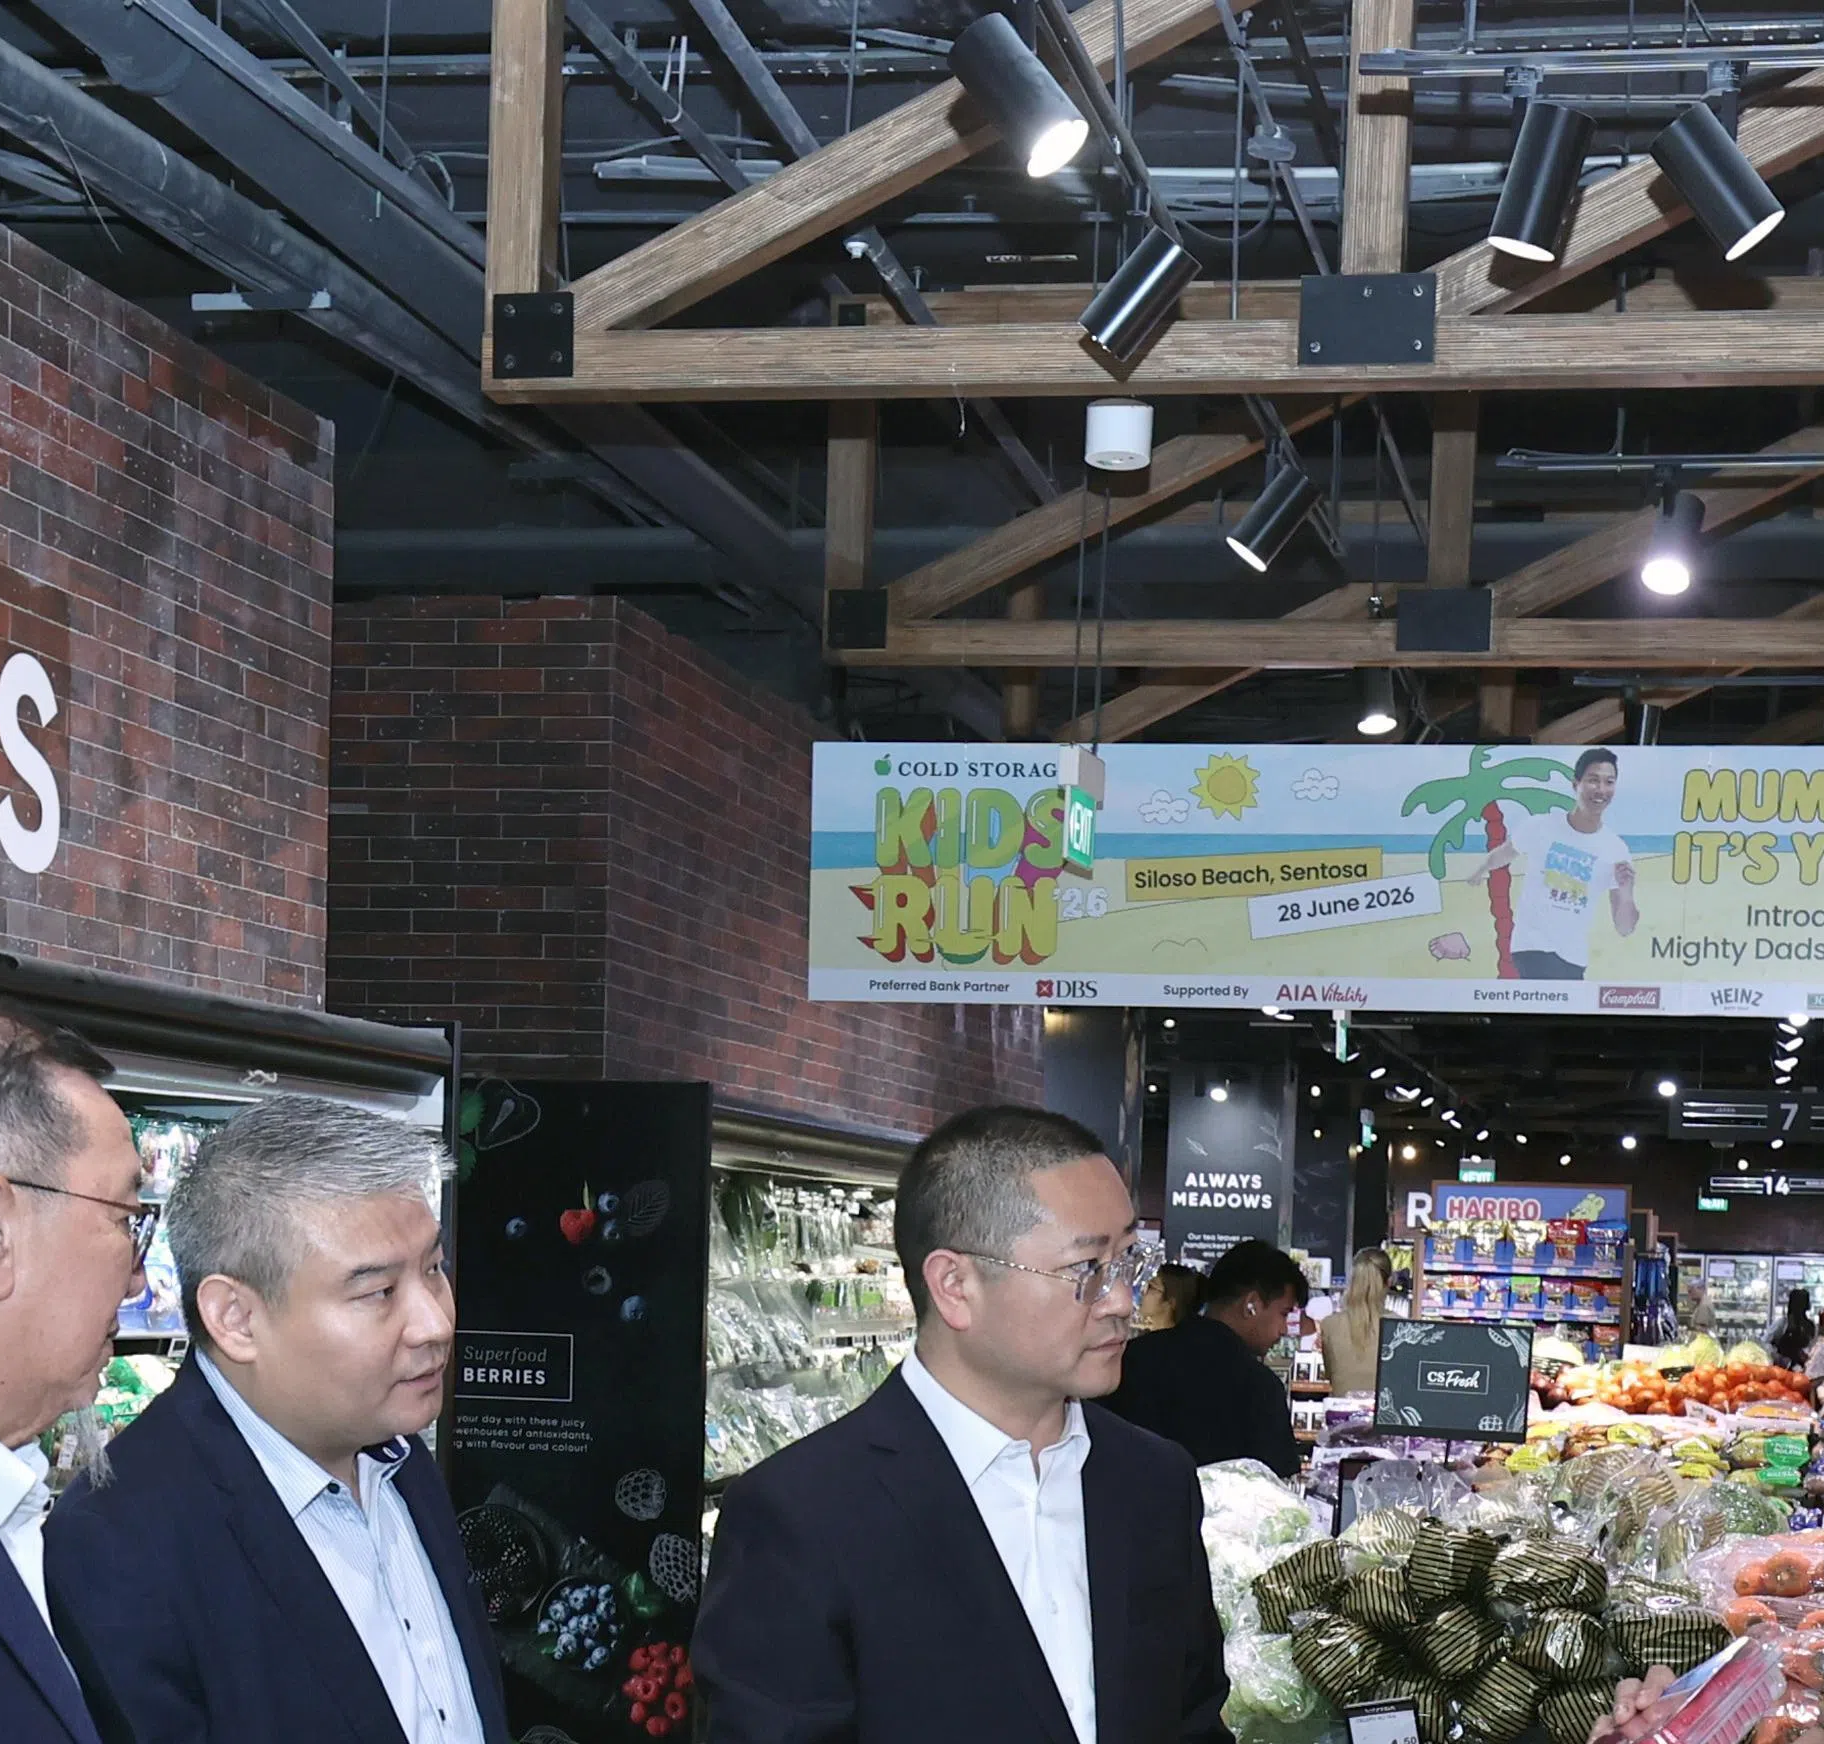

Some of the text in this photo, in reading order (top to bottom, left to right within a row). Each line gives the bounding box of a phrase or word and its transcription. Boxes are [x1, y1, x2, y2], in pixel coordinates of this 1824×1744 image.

[898, 761, 1058, 778] COLD STORAG
[876, 787, 1065, 868] KIDS
[1135, 862, 1368, 888] Siloso Beach, Sentosa
[1278, 886, 1415, 922] 28 June 2026
[873, 875, 1057, 957] RUN
[1651, 937, 1747, 965] Mighty
[869, 980, 1010, 993] Preferred Bank Partner
[1056, 981, 1098, 998] DBS
[1164, 985, 1249, 999] Supported By
[1276, 984, 1368, 1007] AIA Vitality
[1474, 989, 1568, 1002] Event Partners
[1710, 987, 1764, 1007] HEINZ
[1780, 1103, 1799, 1131] 7
[1185, 1172, 1262, 1189] ALWAYS
[1763, 1175, 1790, 1196] 14
[1172, 1191, 1272, 1209] MEADOWS
[1446, 1196, 1541, 1221] HARIBO
[464, 1346, 547, 1364] Superfood
[463, 1367, 546, 1385] BERRIES
[1427, 1369, 1480, 1388] CS Fresh
[457, 1415, 585, 1429] your day with these juicy
[512, 1428, 523, 1437] of
[466, 1440, 588, 1453] with flavour and colour!
